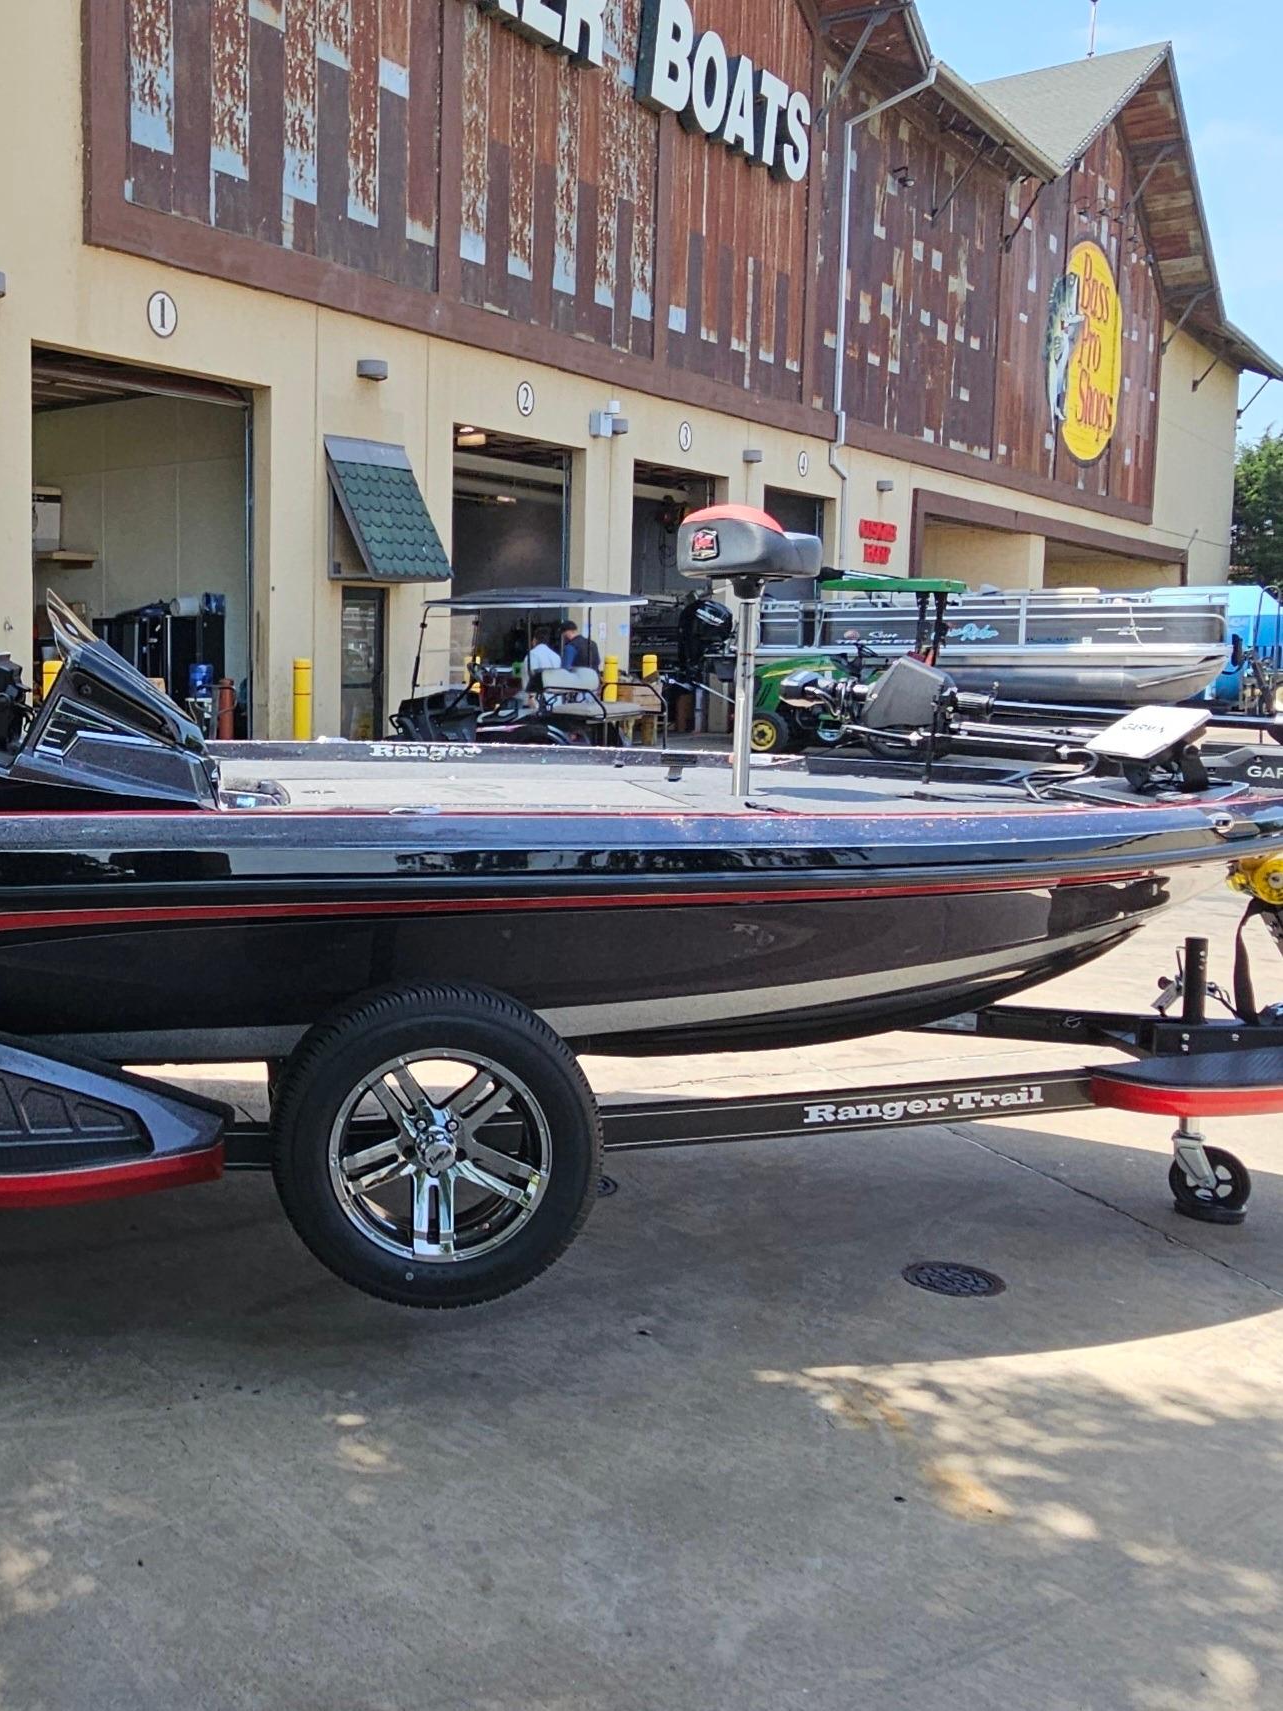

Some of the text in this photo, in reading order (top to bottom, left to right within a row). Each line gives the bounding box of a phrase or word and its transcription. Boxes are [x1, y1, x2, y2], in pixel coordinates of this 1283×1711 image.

[651, 0, 811, 182] BOATS
[1080, 251, 1111, 324] Bass
[1078, 313, 1102, 373] Pro
[1075, 368, 1113, 442] Shops
[369, 743, 483, 761] Ranger
[803, 1085, 1045, 1124] Ranger Trail
